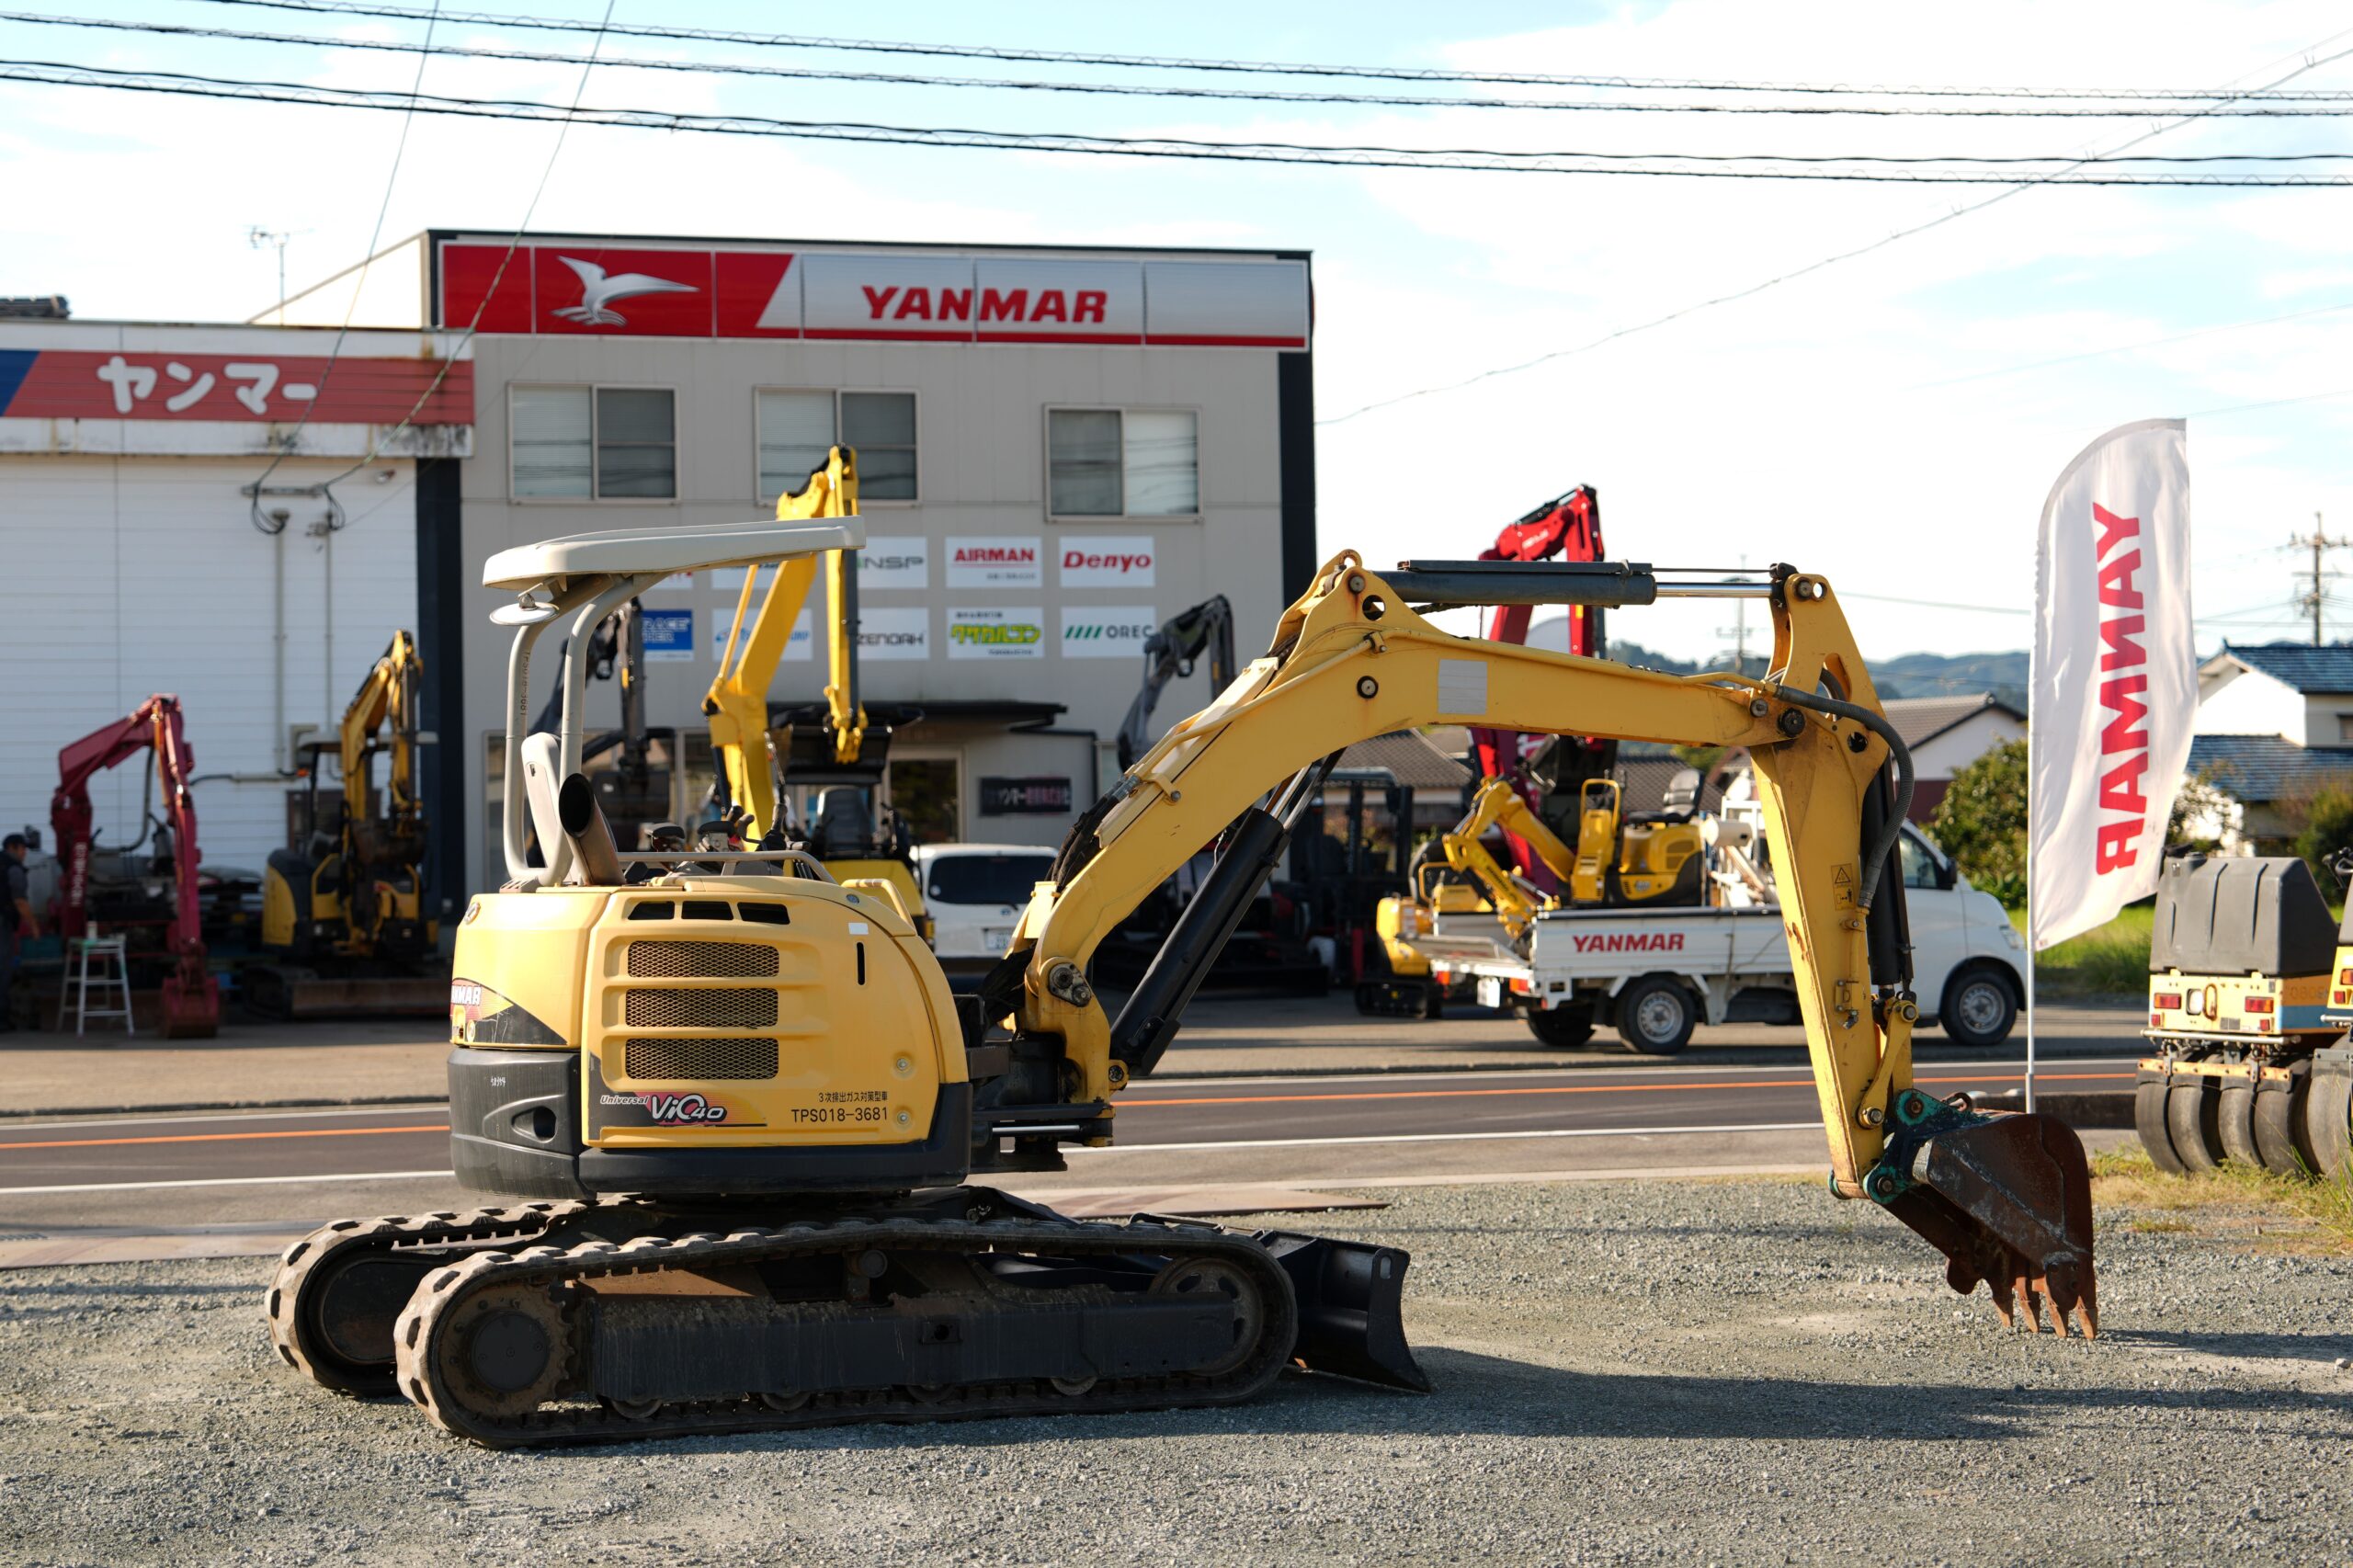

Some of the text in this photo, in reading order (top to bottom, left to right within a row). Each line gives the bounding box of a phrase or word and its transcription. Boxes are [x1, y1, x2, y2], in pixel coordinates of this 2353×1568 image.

[861, 285, 1108, 324] YANMAR
[97, 356, 317, 415] ヤンマー
[954, 548, 1035, 562] AIRMAN
[1063, 551, 1153, 574] Denyo
[1106, 625, 1154, 640] OREC
[1573, 933, 1685, 952] YANMAR
[600, 1095, 650, 1105] Universal
[791, 1108, 887, 1122] TPS018-3681
